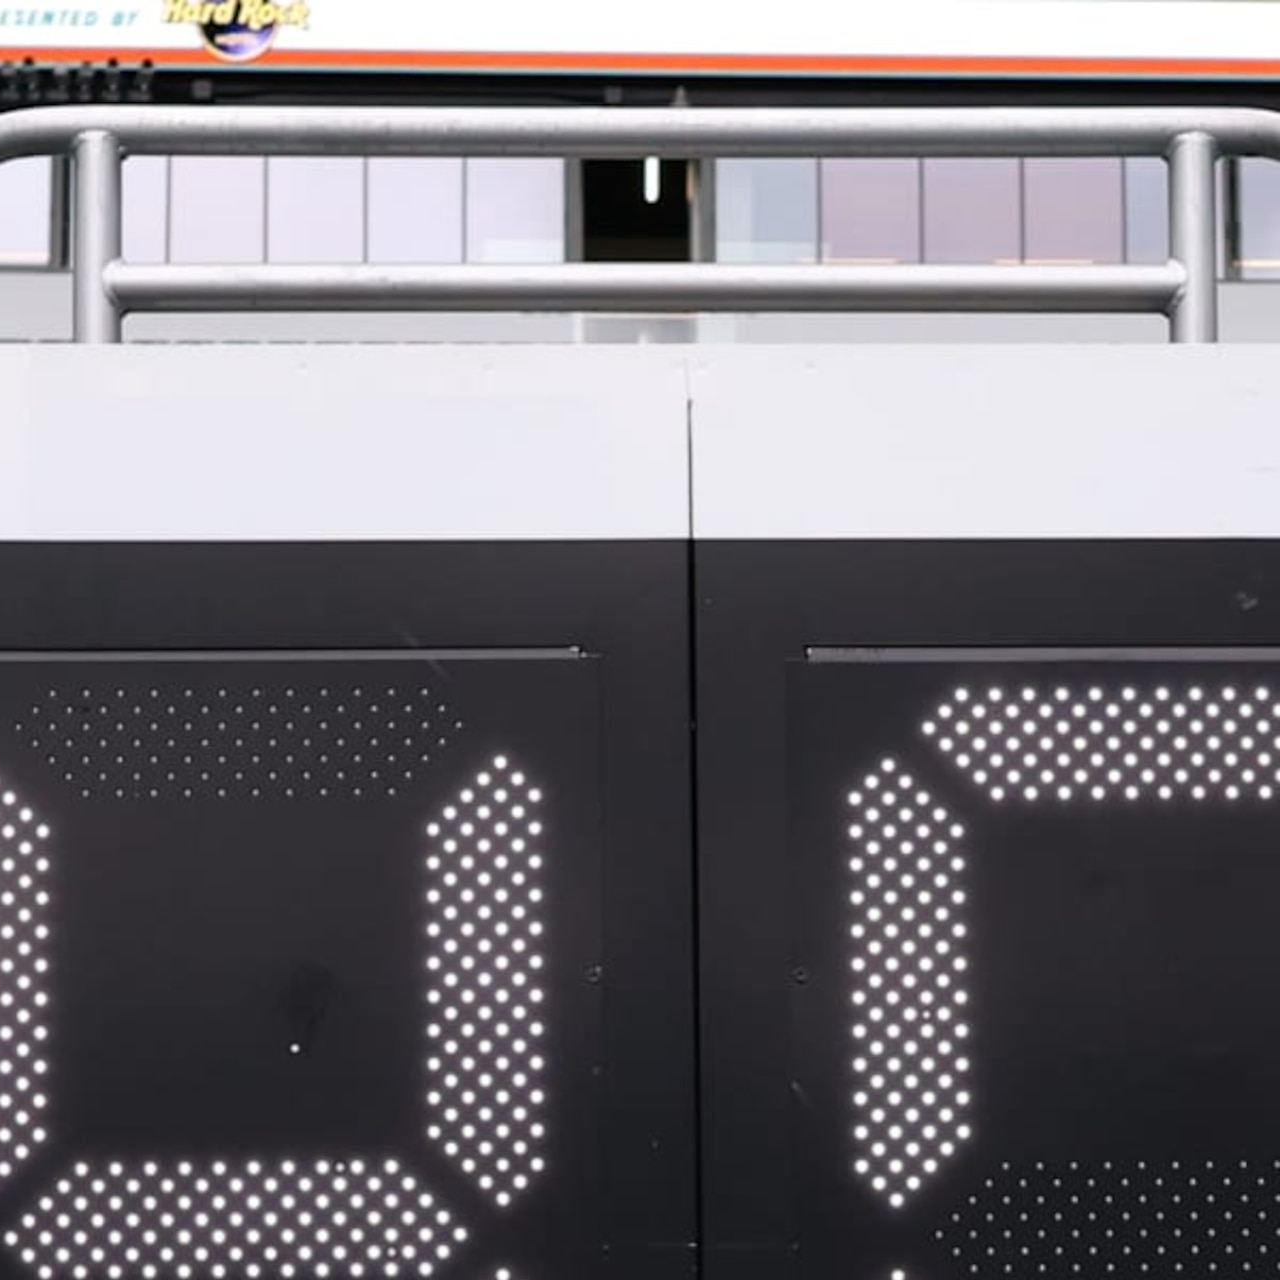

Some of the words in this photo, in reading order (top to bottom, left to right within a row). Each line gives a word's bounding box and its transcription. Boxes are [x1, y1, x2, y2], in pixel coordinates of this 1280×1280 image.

[110, 10, 140, 27] BY
[162, 0, 234, 24] Hard
[236, 0, 309, 31] Rock
